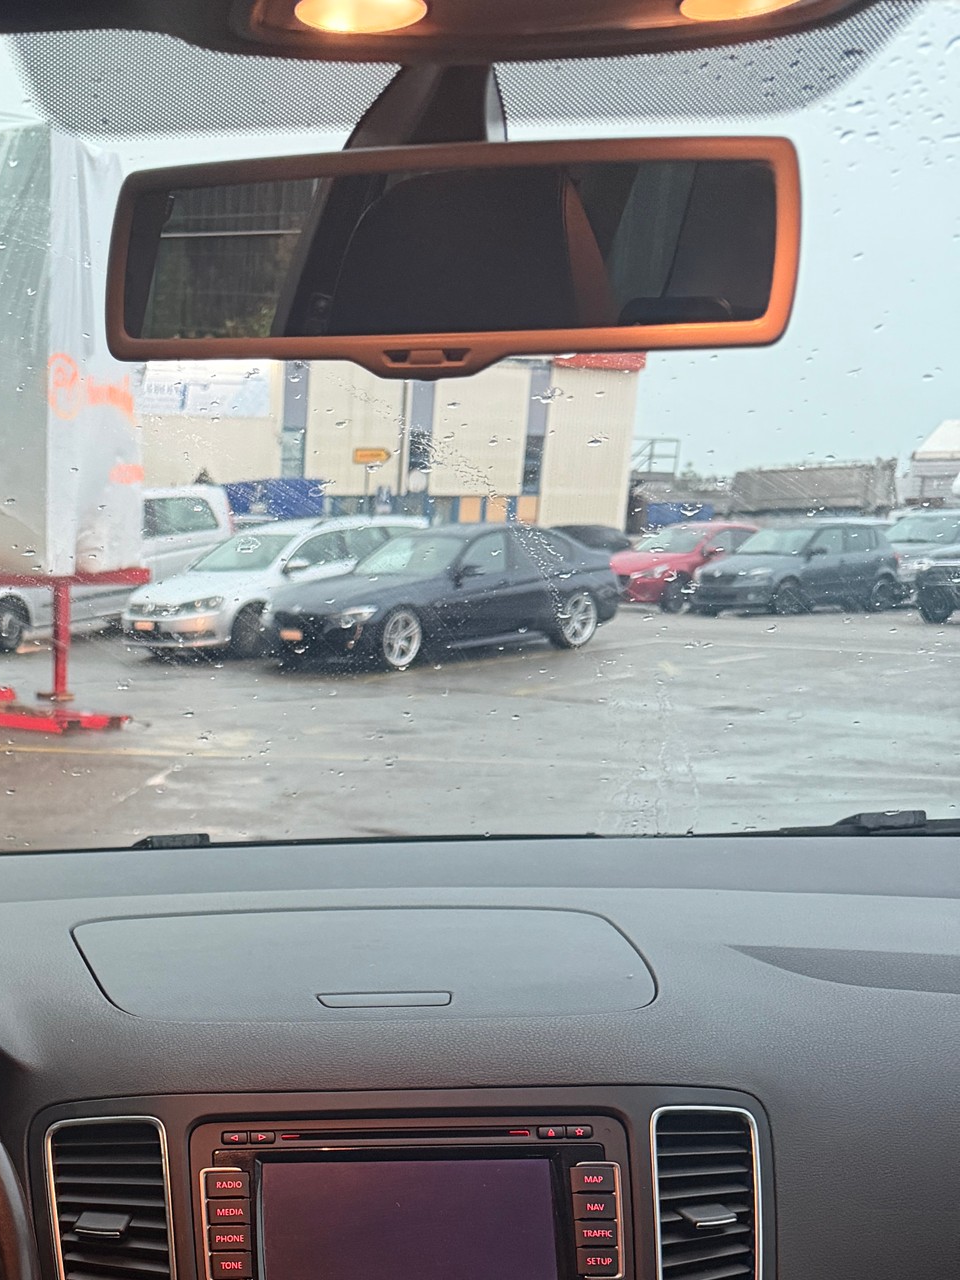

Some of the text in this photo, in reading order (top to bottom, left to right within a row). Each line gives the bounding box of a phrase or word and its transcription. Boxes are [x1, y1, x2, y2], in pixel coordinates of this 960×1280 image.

[584, 1175, 603, 1184] MAP
[216, 1180, 243, 1189] RADIO
[586, 1203, 605, 1211] NAV
[216, 1208, 244, 1217] MEDIA
[582, 1229, 613, 1238] TRAFFIC
[215, 1234, 244, 1243] PHONE
[220, 1261, 243, 1270] TONE
[586, 1257, 613, 1266] SETUP
